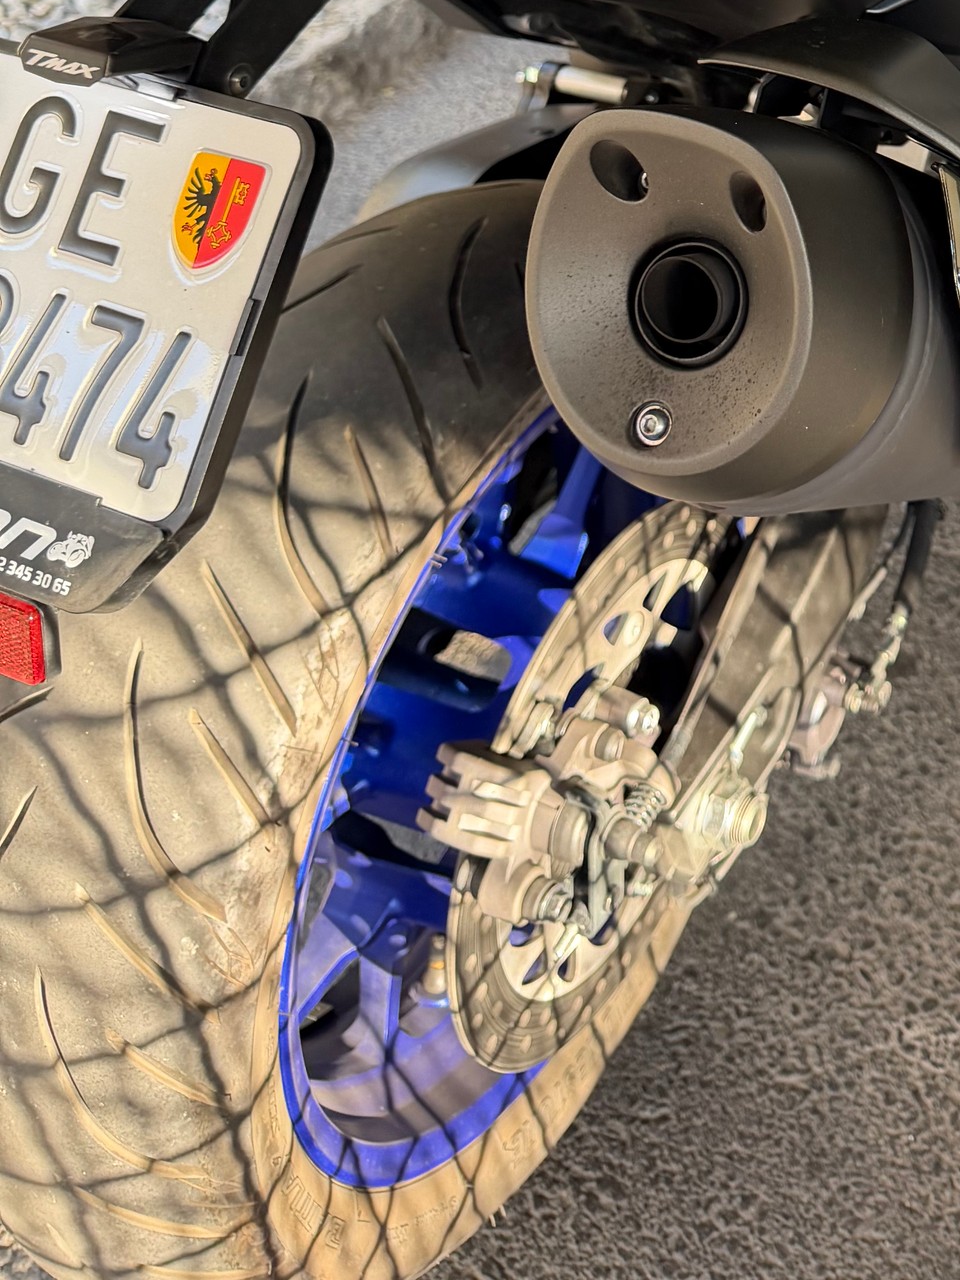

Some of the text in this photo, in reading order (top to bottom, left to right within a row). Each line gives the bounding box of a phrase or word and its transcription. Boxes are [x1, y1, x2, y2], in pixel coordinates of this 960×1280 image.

[23, 47, 101, 80] TMAX
[0, 95, 167, 267] GE
[6, 560, 33, 581] 345
[32, 570, 52, 588] 30
[52, 578, 72, 596] 65
